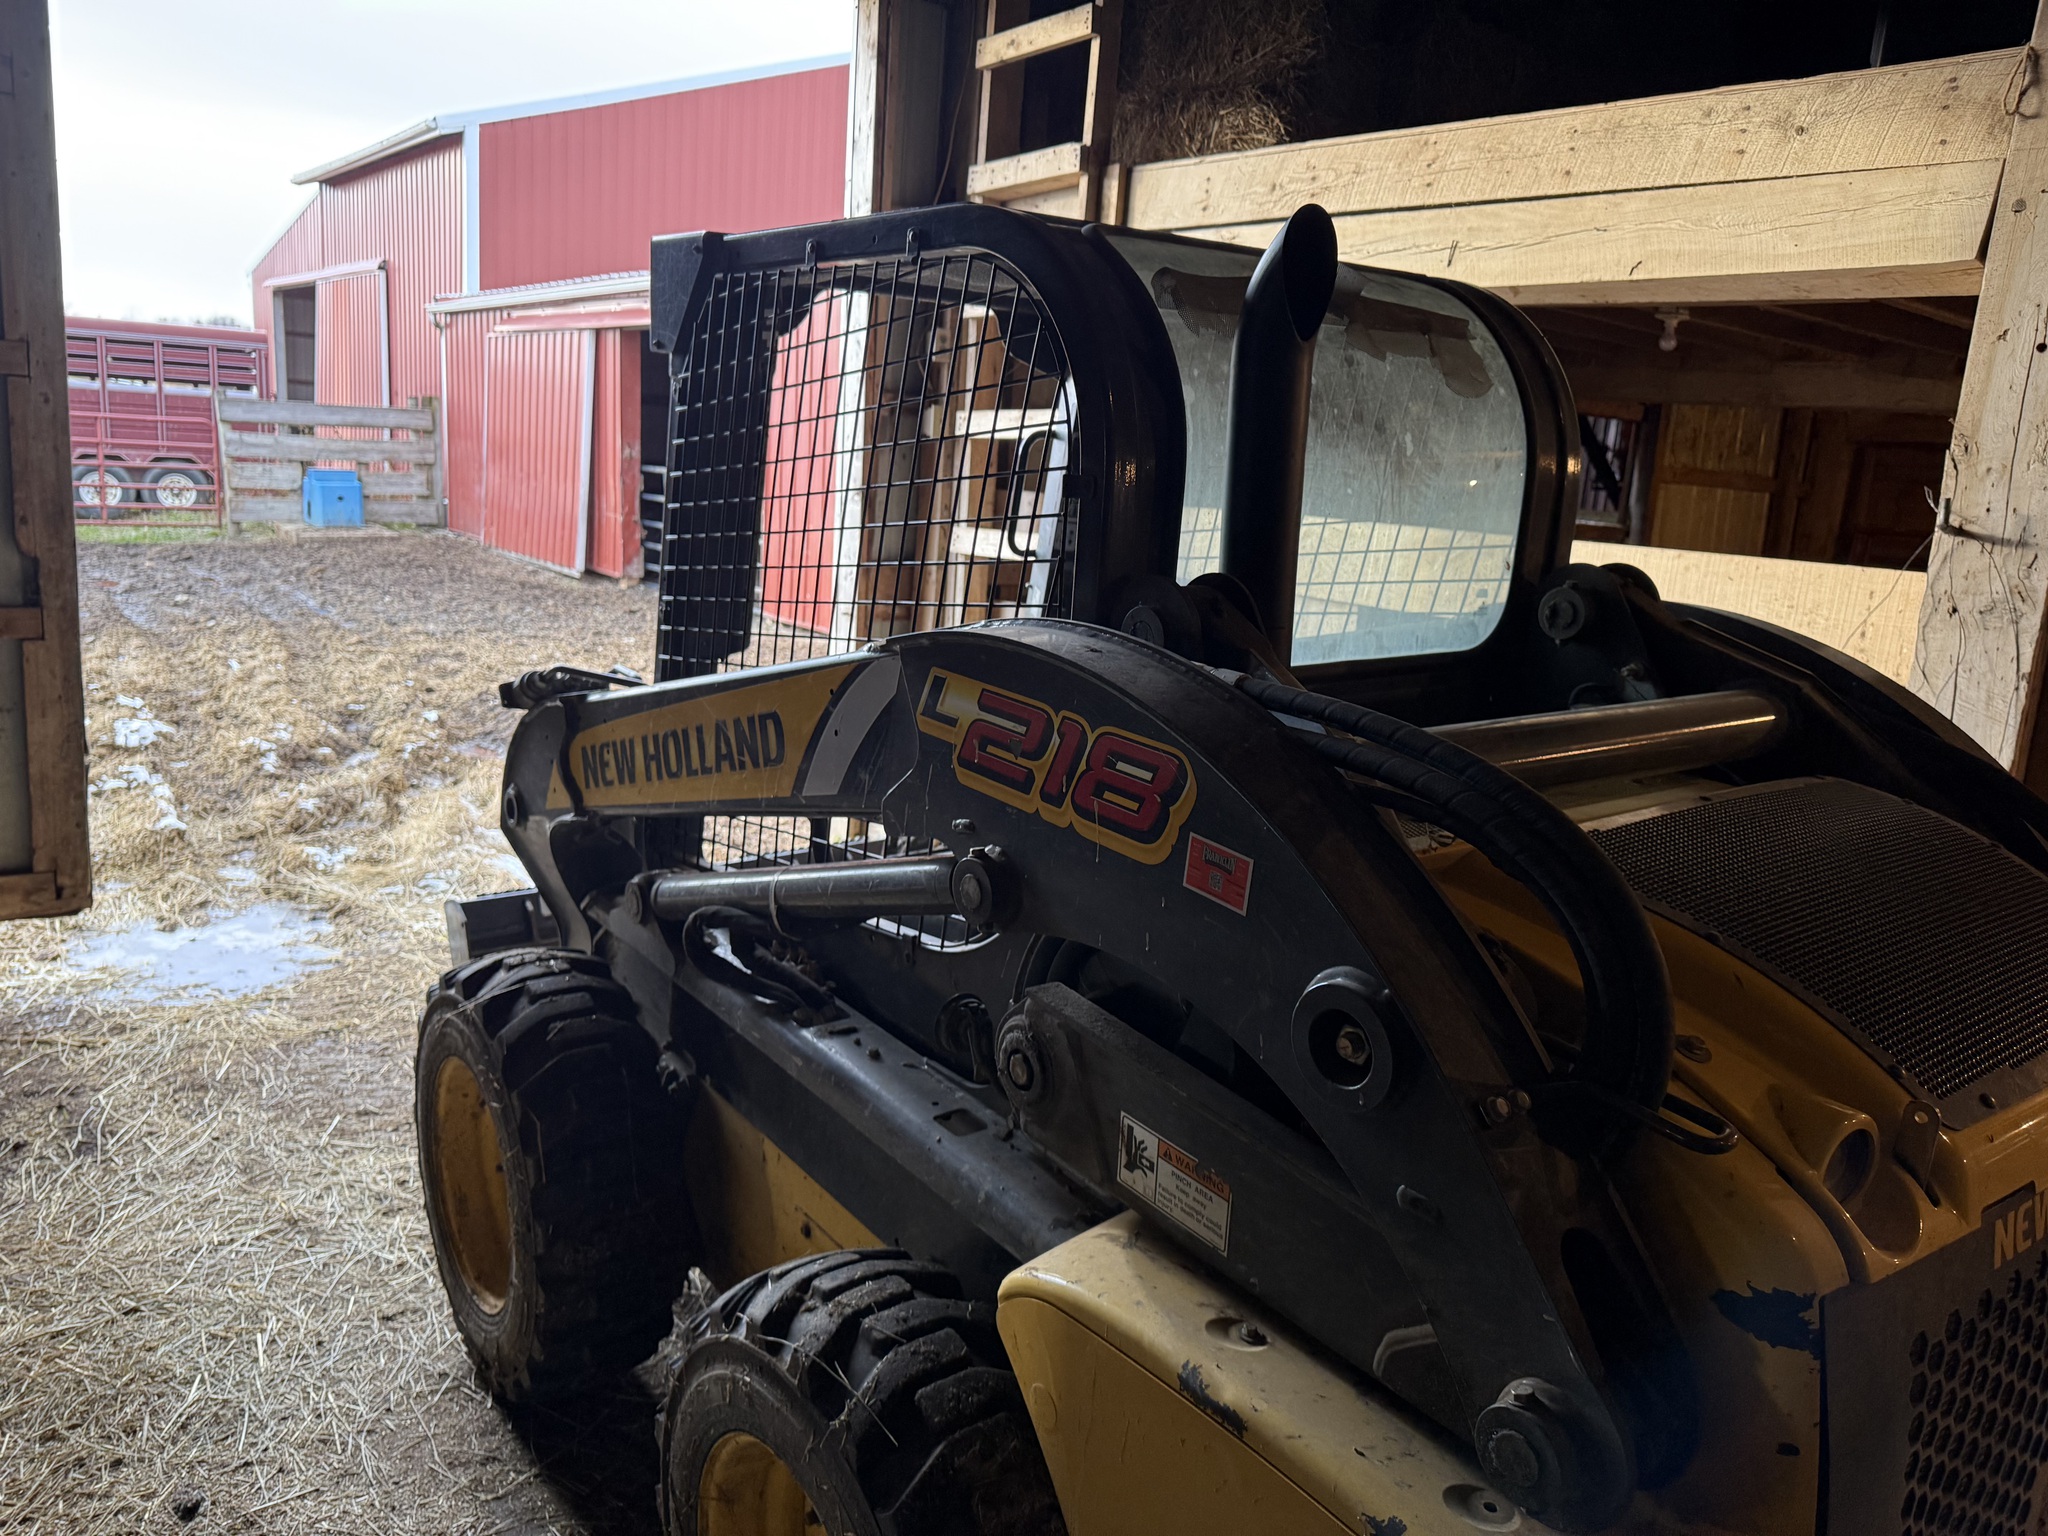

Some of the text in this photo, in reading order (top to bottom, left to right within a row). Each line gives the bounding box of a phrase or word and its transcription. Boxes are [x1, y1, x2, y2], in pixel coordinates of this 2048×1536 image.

[581, 710, 785, 789] NEW HOLLAND
[918, 671, 1194, 852] L218
[1171, 1170, 1213, 1204] PINCH AREA
